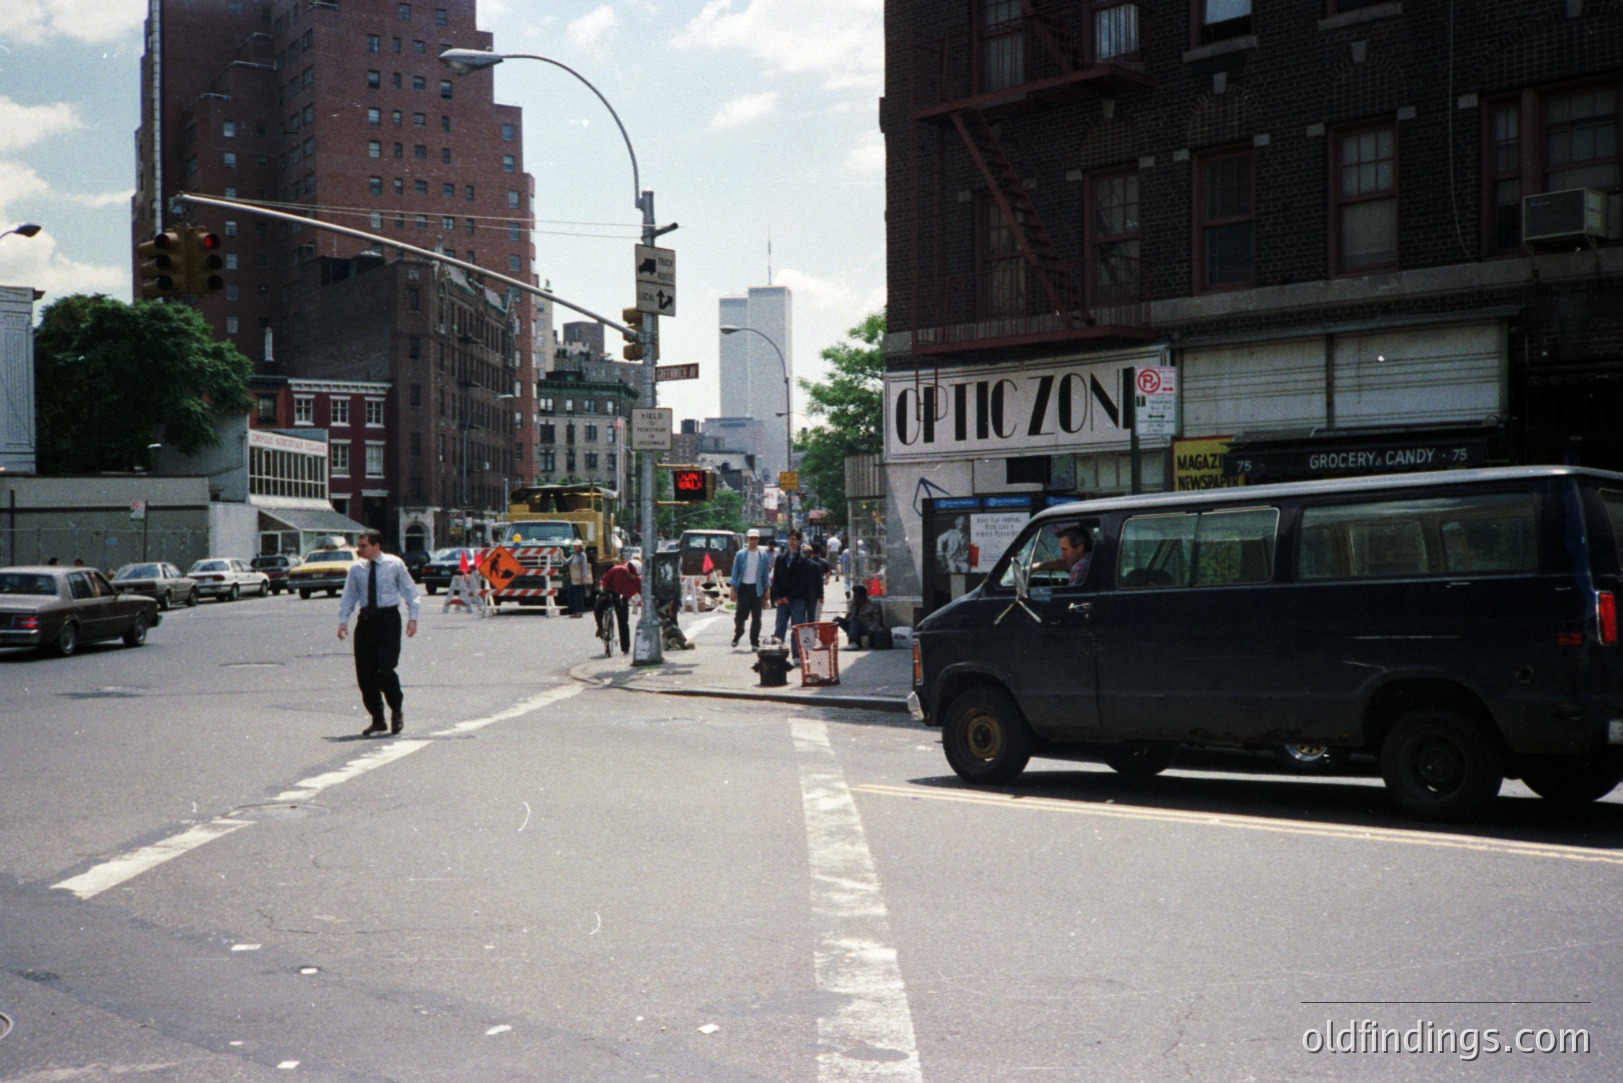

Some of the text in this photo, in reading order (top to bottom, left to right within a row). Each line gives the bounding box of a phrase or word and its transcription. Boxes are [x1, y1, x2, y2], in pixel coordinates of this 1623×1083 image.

[641, 412, 664, 420] YIELD
[895, 378, 1019, 446] OPTIC
[1236, 460, 1252, 473] 75
[1309, 452, 1377, 470] GROCERY
[1385, 447, 1436, 466] CANDY
[1452, 448, 1468, 461] 75
[677, 480, 703, 490] WALK
